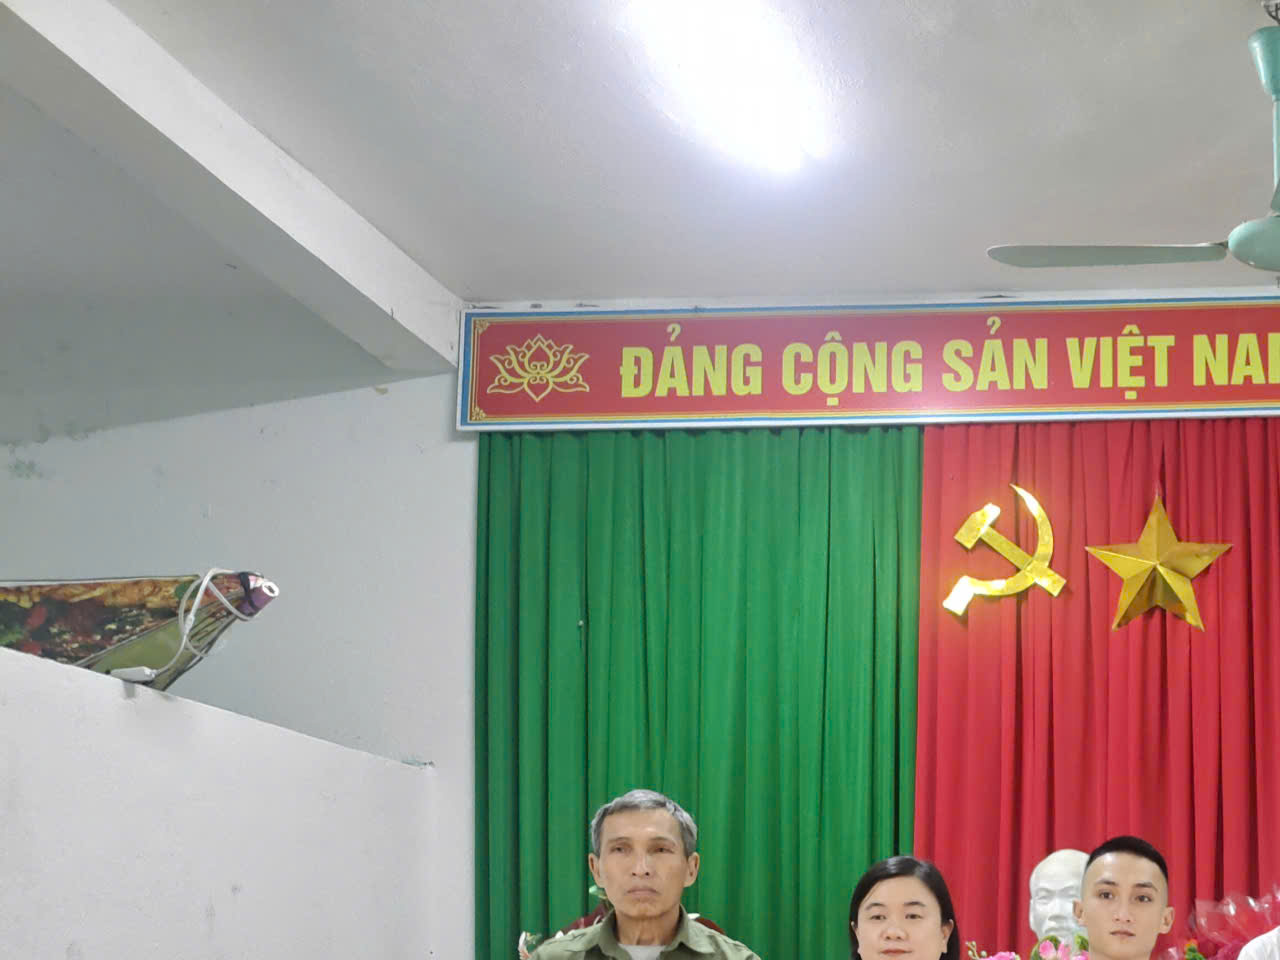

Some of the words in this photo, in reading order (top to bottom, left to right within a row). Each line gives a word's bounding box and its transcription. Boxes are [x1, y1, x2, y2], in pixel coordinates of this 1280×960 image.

[620, 323, 763, 398] ĐẢNG
[782, 331, 923, 406] CỘNG
[941, 316, 1048, 392] SẢN
[1066, 324, 1175, 400] VIỆT
